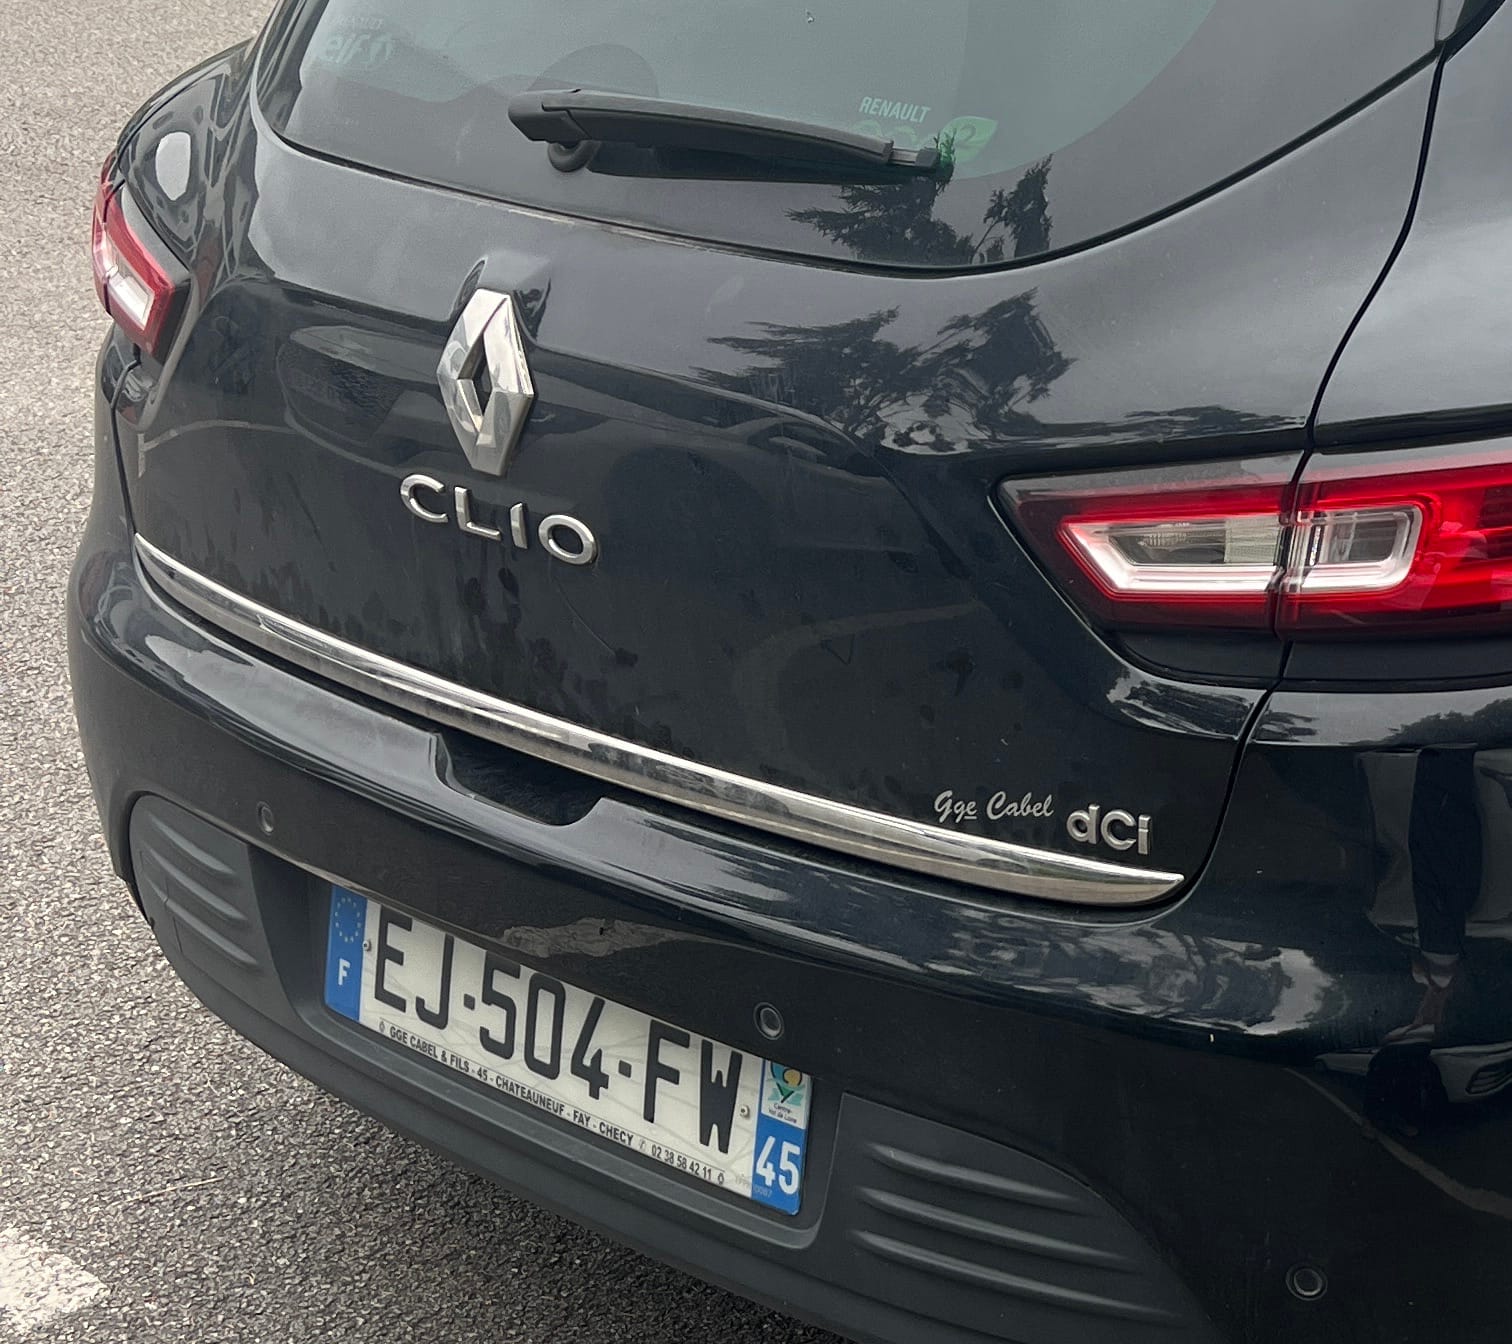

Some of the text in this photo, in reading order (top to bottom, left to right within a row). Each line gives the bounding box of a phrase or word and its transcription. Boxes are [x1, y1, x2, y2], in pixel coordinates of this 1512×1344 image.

[858, 96, 931, 123] RENAULT
[400, 473, 597, 566] CLIO
[933, 789, 1054, 824] Gge Cabel
[1066, 803, 1152, 855] dCi
[338, 958, 351, 986] F
[374, 904, 744, 1156] EJ-504-FW
[389, 1025, 408, 1045] GGE
[410, 1035, 438, 1059] CABEL
[440, 1050, 448, 1063] &
[450, 1054, 470, 1074] FILS
[477, 1066, 488, 1081] 45
[495, 1075, 566, 1117] CHATEAUNEUF
[573, 1109, 592, 1128] FAY
[599, 1121, 635, 1147] CHECY
[651, 1144, 663, 1159] 02
[664, 1149, 675, 1164] 38
[676, 1155, 687, 1168] 58
[689, 1161, 700, 1176] 42
[702, 1166, 712, 1181] 11
[755, 1135, 801, 1196] 45
